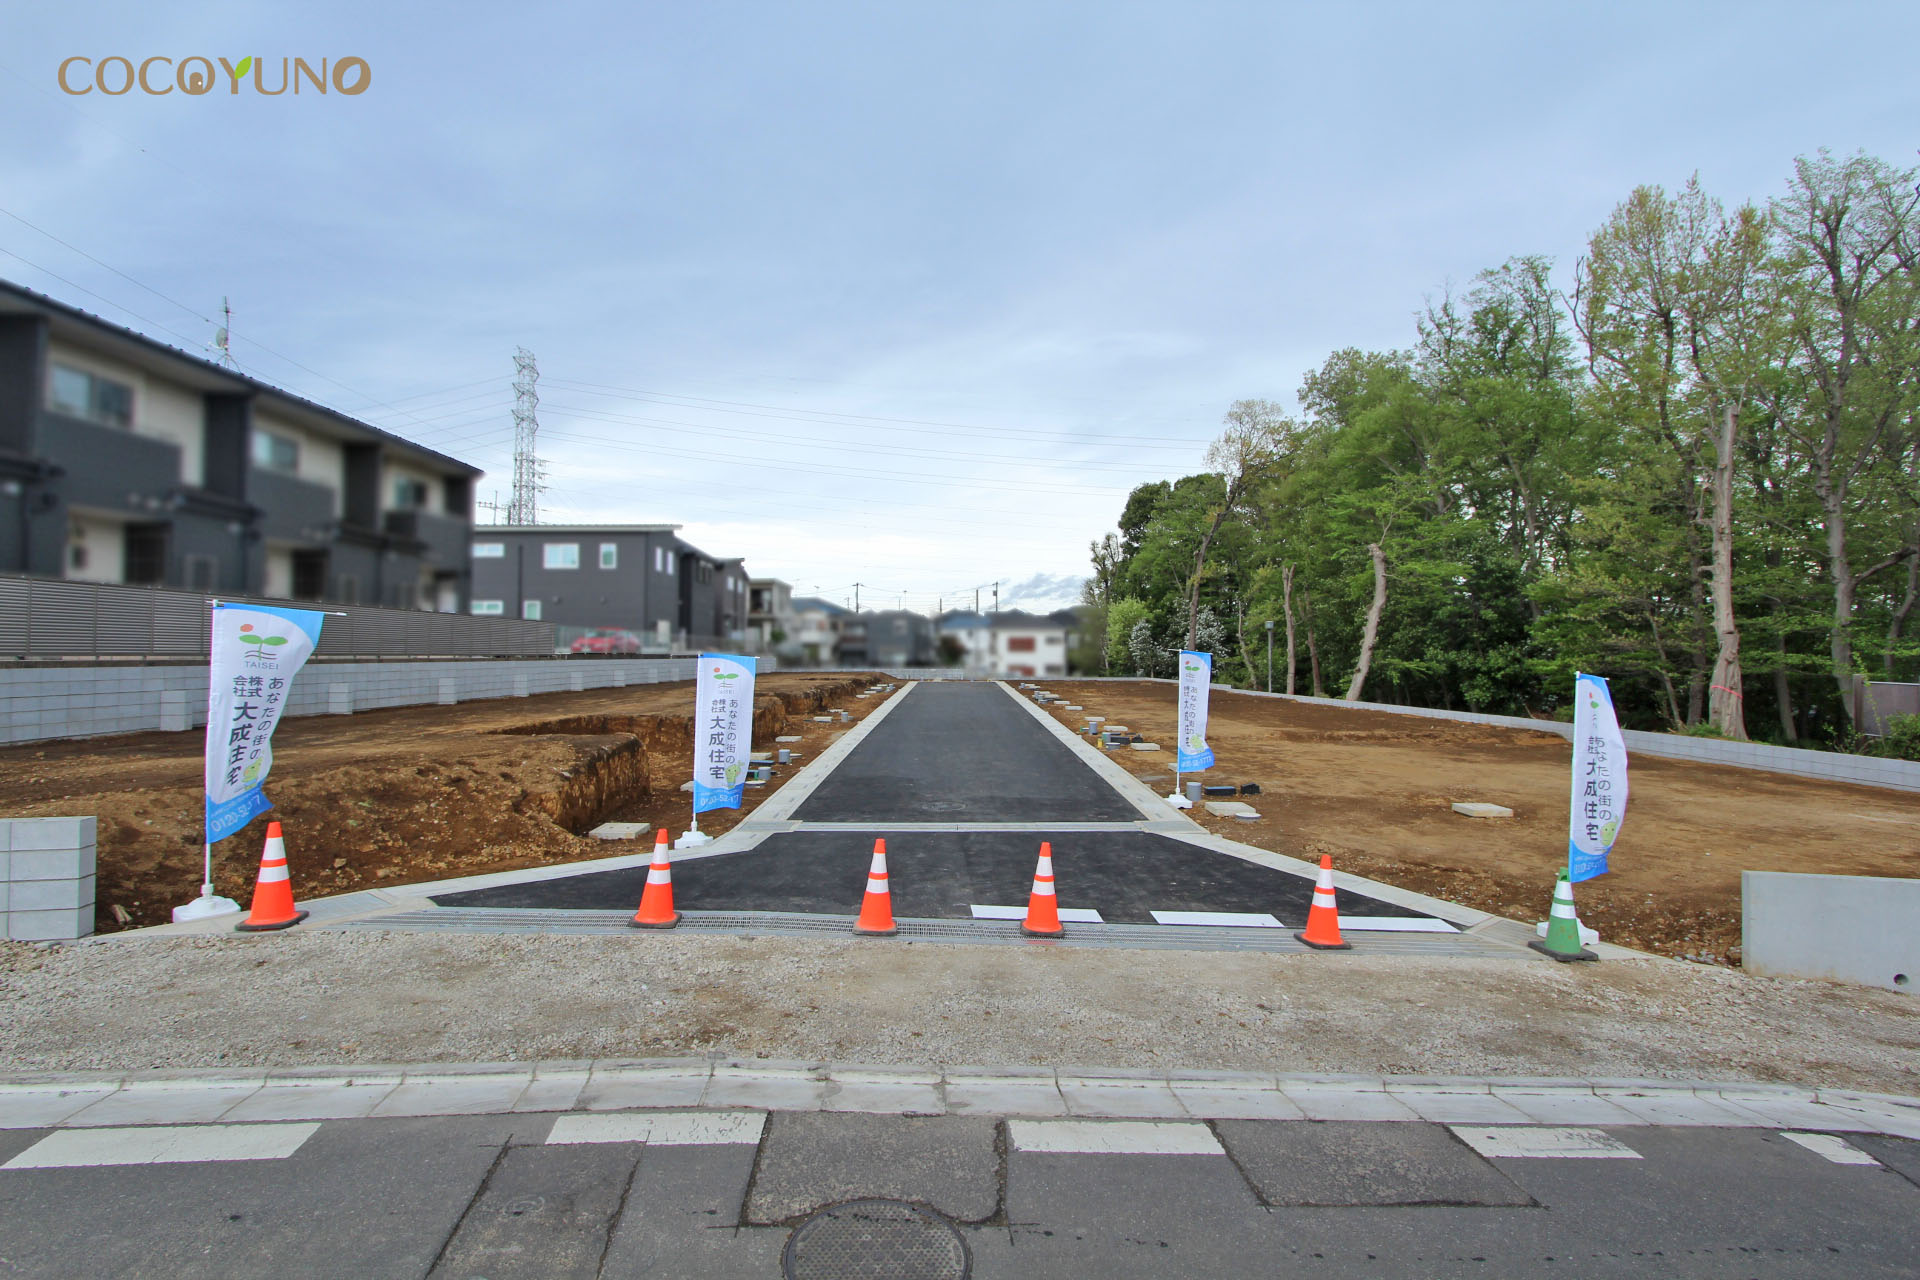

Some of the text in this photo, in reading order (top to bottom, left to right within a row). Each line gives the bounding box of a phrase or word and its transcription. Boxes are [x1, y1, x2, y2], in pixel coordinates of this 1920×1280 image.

[245, 661, 279, 670] TAISEI
[250, 677, 285, 760] あなたの街の
[708, 716, 726, 780] 大成住宅
[725, 699, 738, 764] あなたの街の
